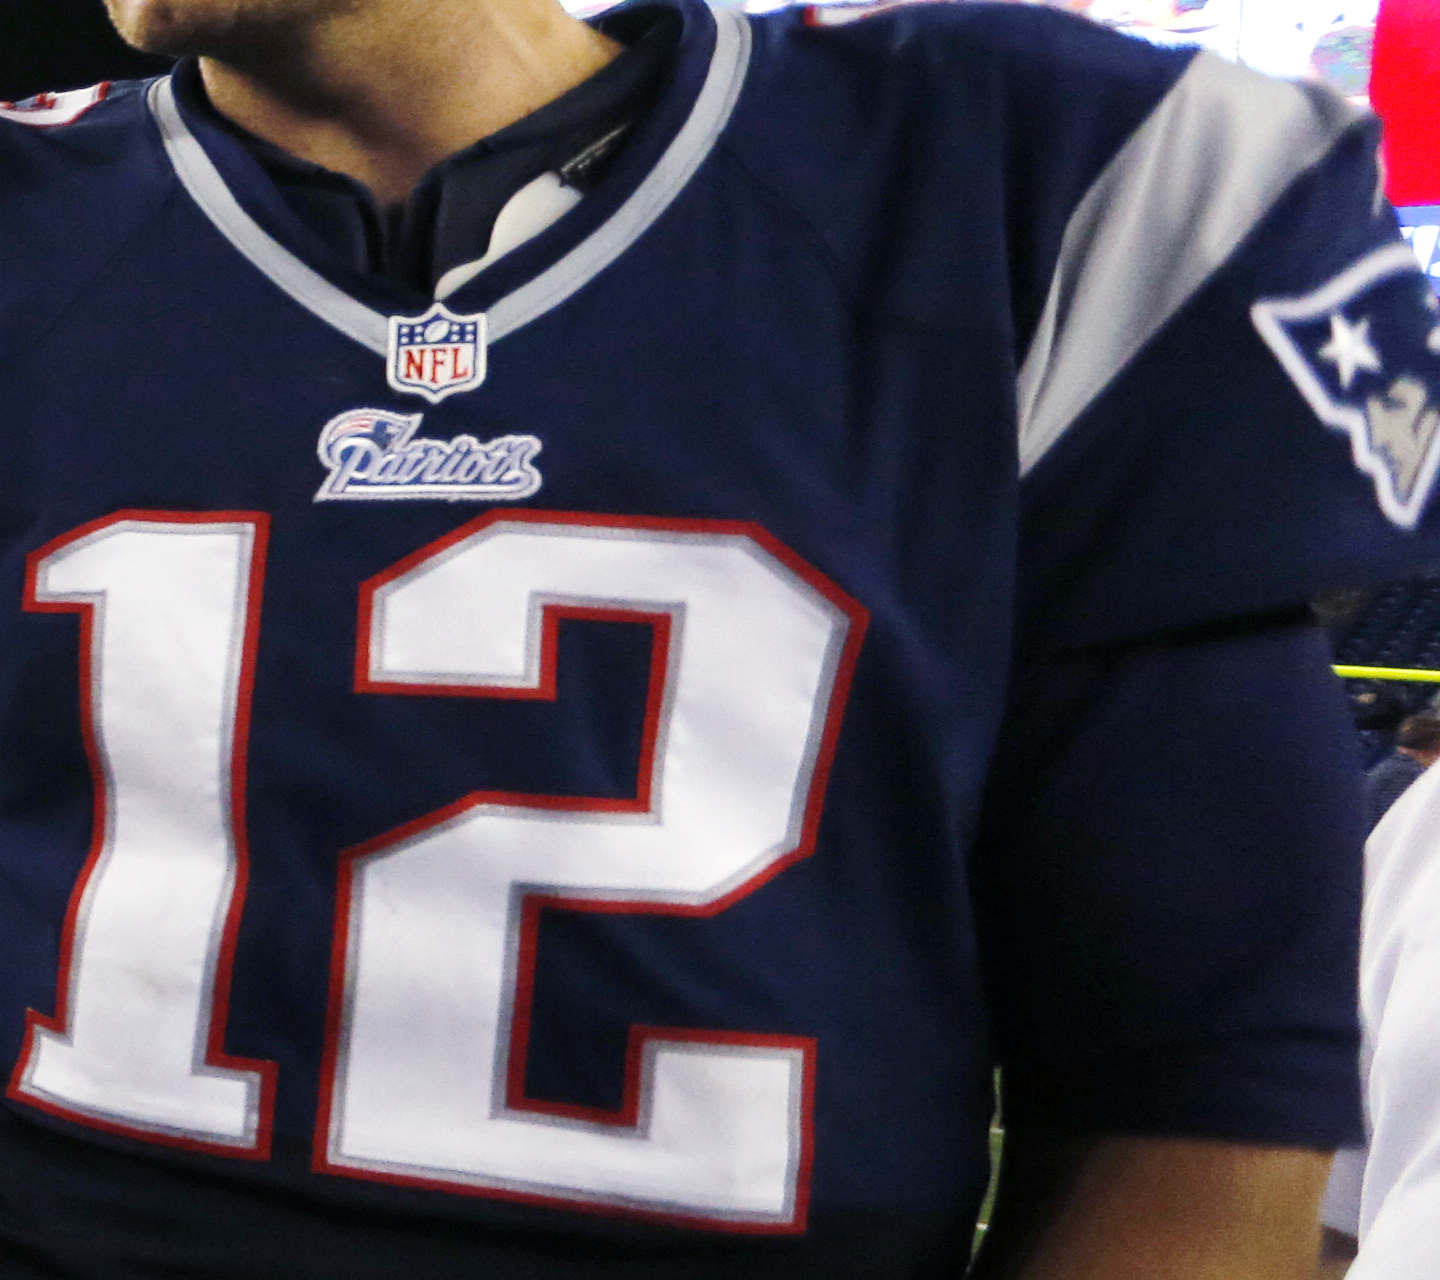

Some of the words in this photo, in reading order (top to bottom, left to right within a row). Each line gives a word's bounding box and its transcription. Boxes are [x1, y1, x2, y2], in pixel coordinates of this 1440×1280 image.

[402, 346, 469, 384] NFL
[322, 423, 539, 497] Patriots
[6, 509, 870, 1235] 12
